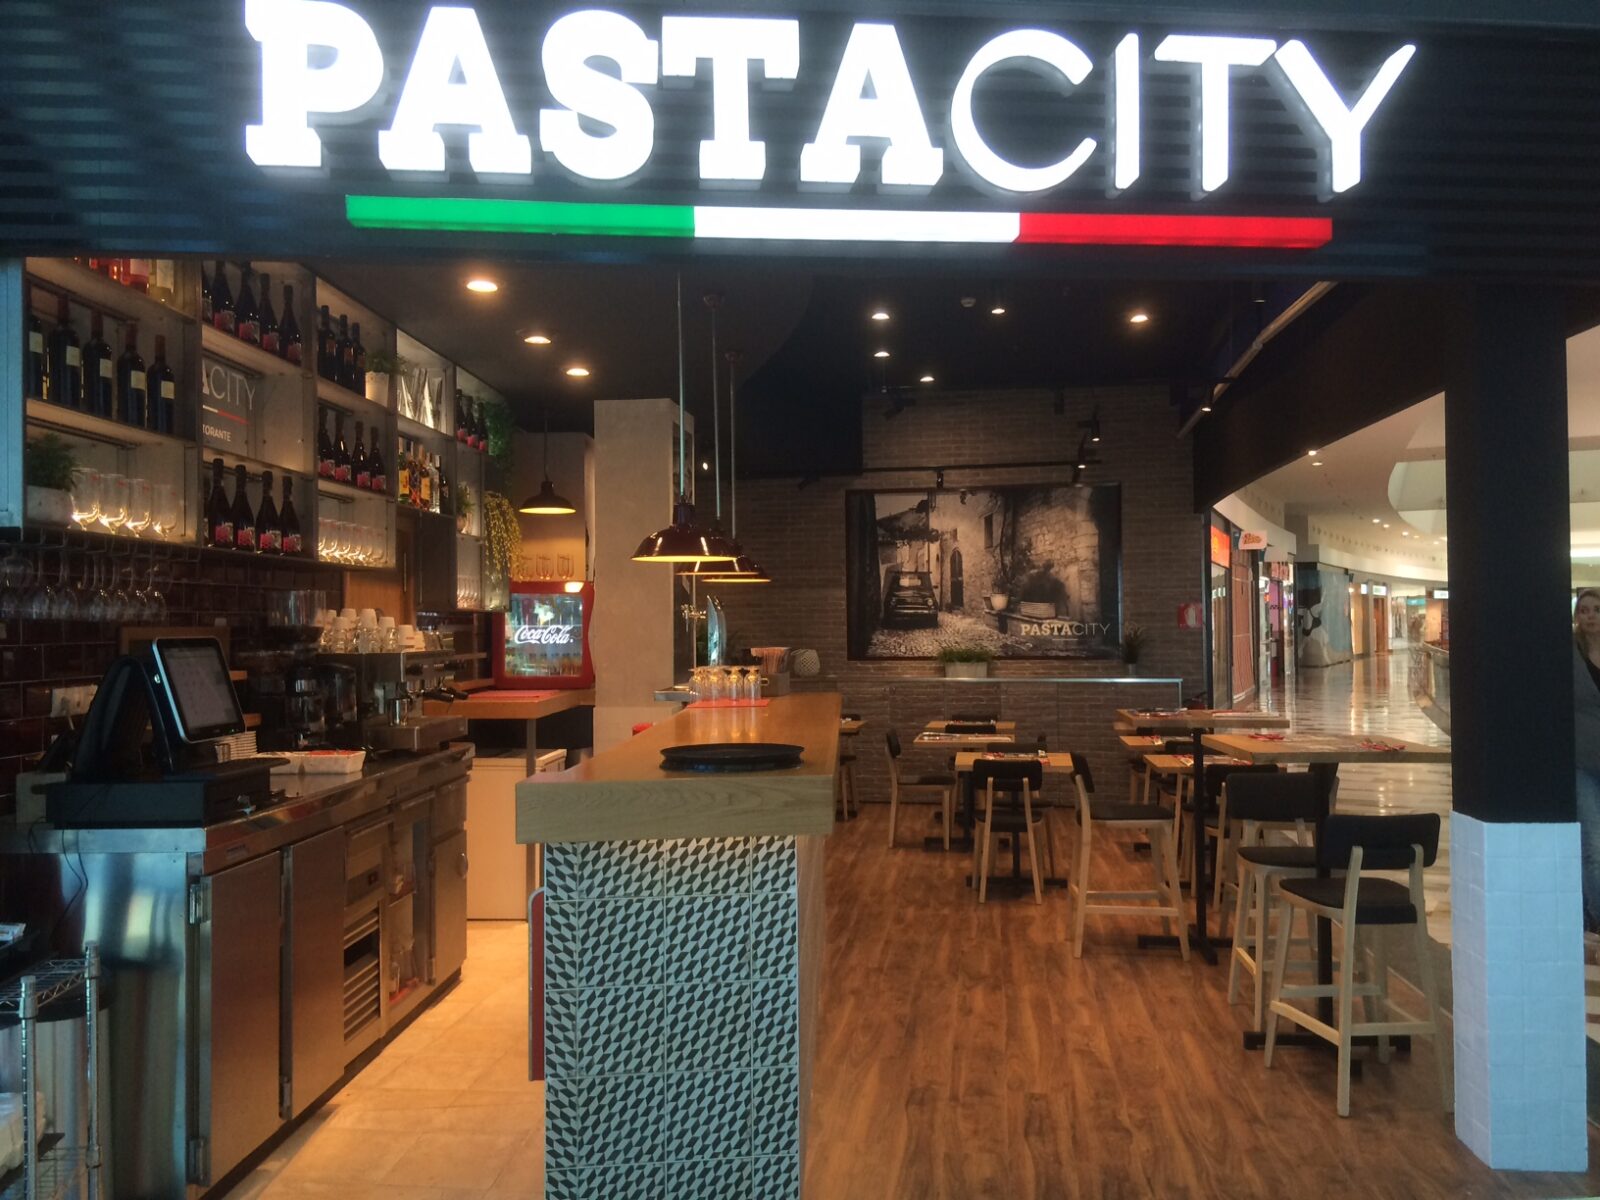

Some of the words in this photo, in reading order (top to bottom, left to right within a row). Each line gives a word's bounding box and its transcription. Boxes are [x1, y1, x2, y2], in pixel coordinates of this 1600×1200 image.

[244, 0, 1417, 194] PASTACITY
[514, 625, 574, 645] Coca-Cola
[1020, 623, 1111, 637] PASTACITY
